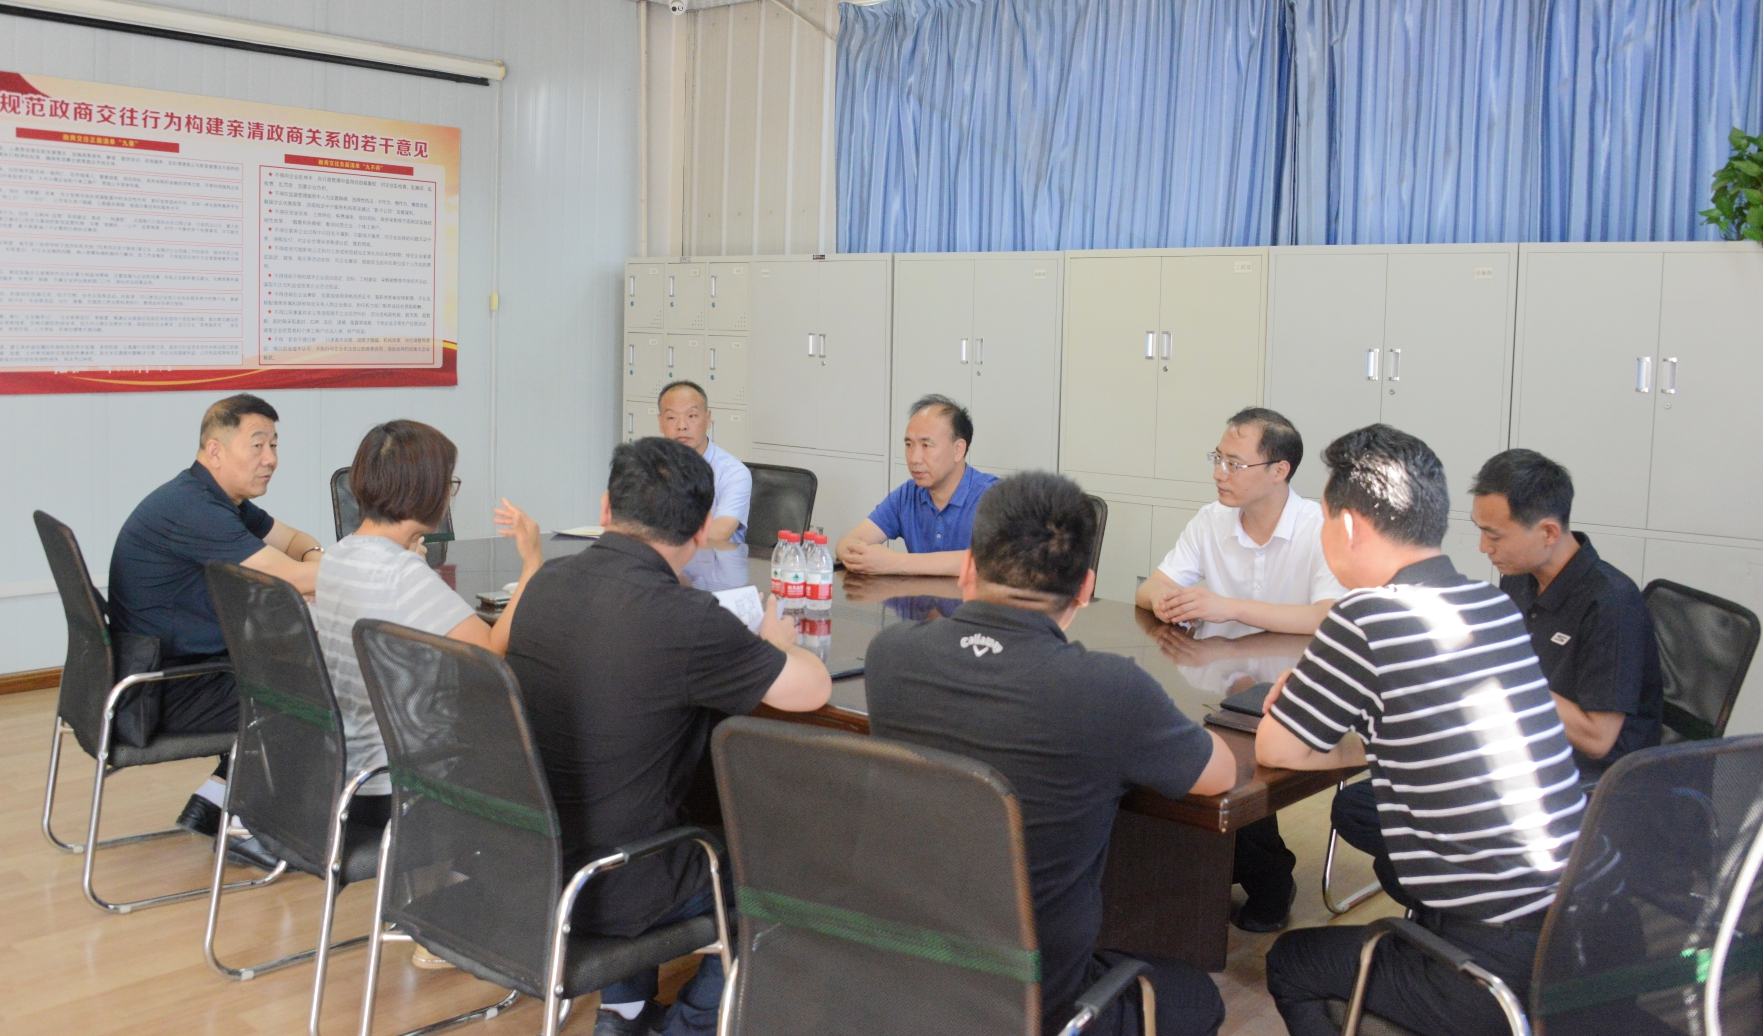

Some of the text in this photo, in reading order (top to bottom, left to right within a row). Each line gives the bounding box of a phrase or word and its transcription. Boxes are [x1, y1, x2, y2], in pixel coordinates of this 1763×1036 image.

[0, 93, 429, 158] 规范政商交往行为构建亲清政商关系的若干意见
